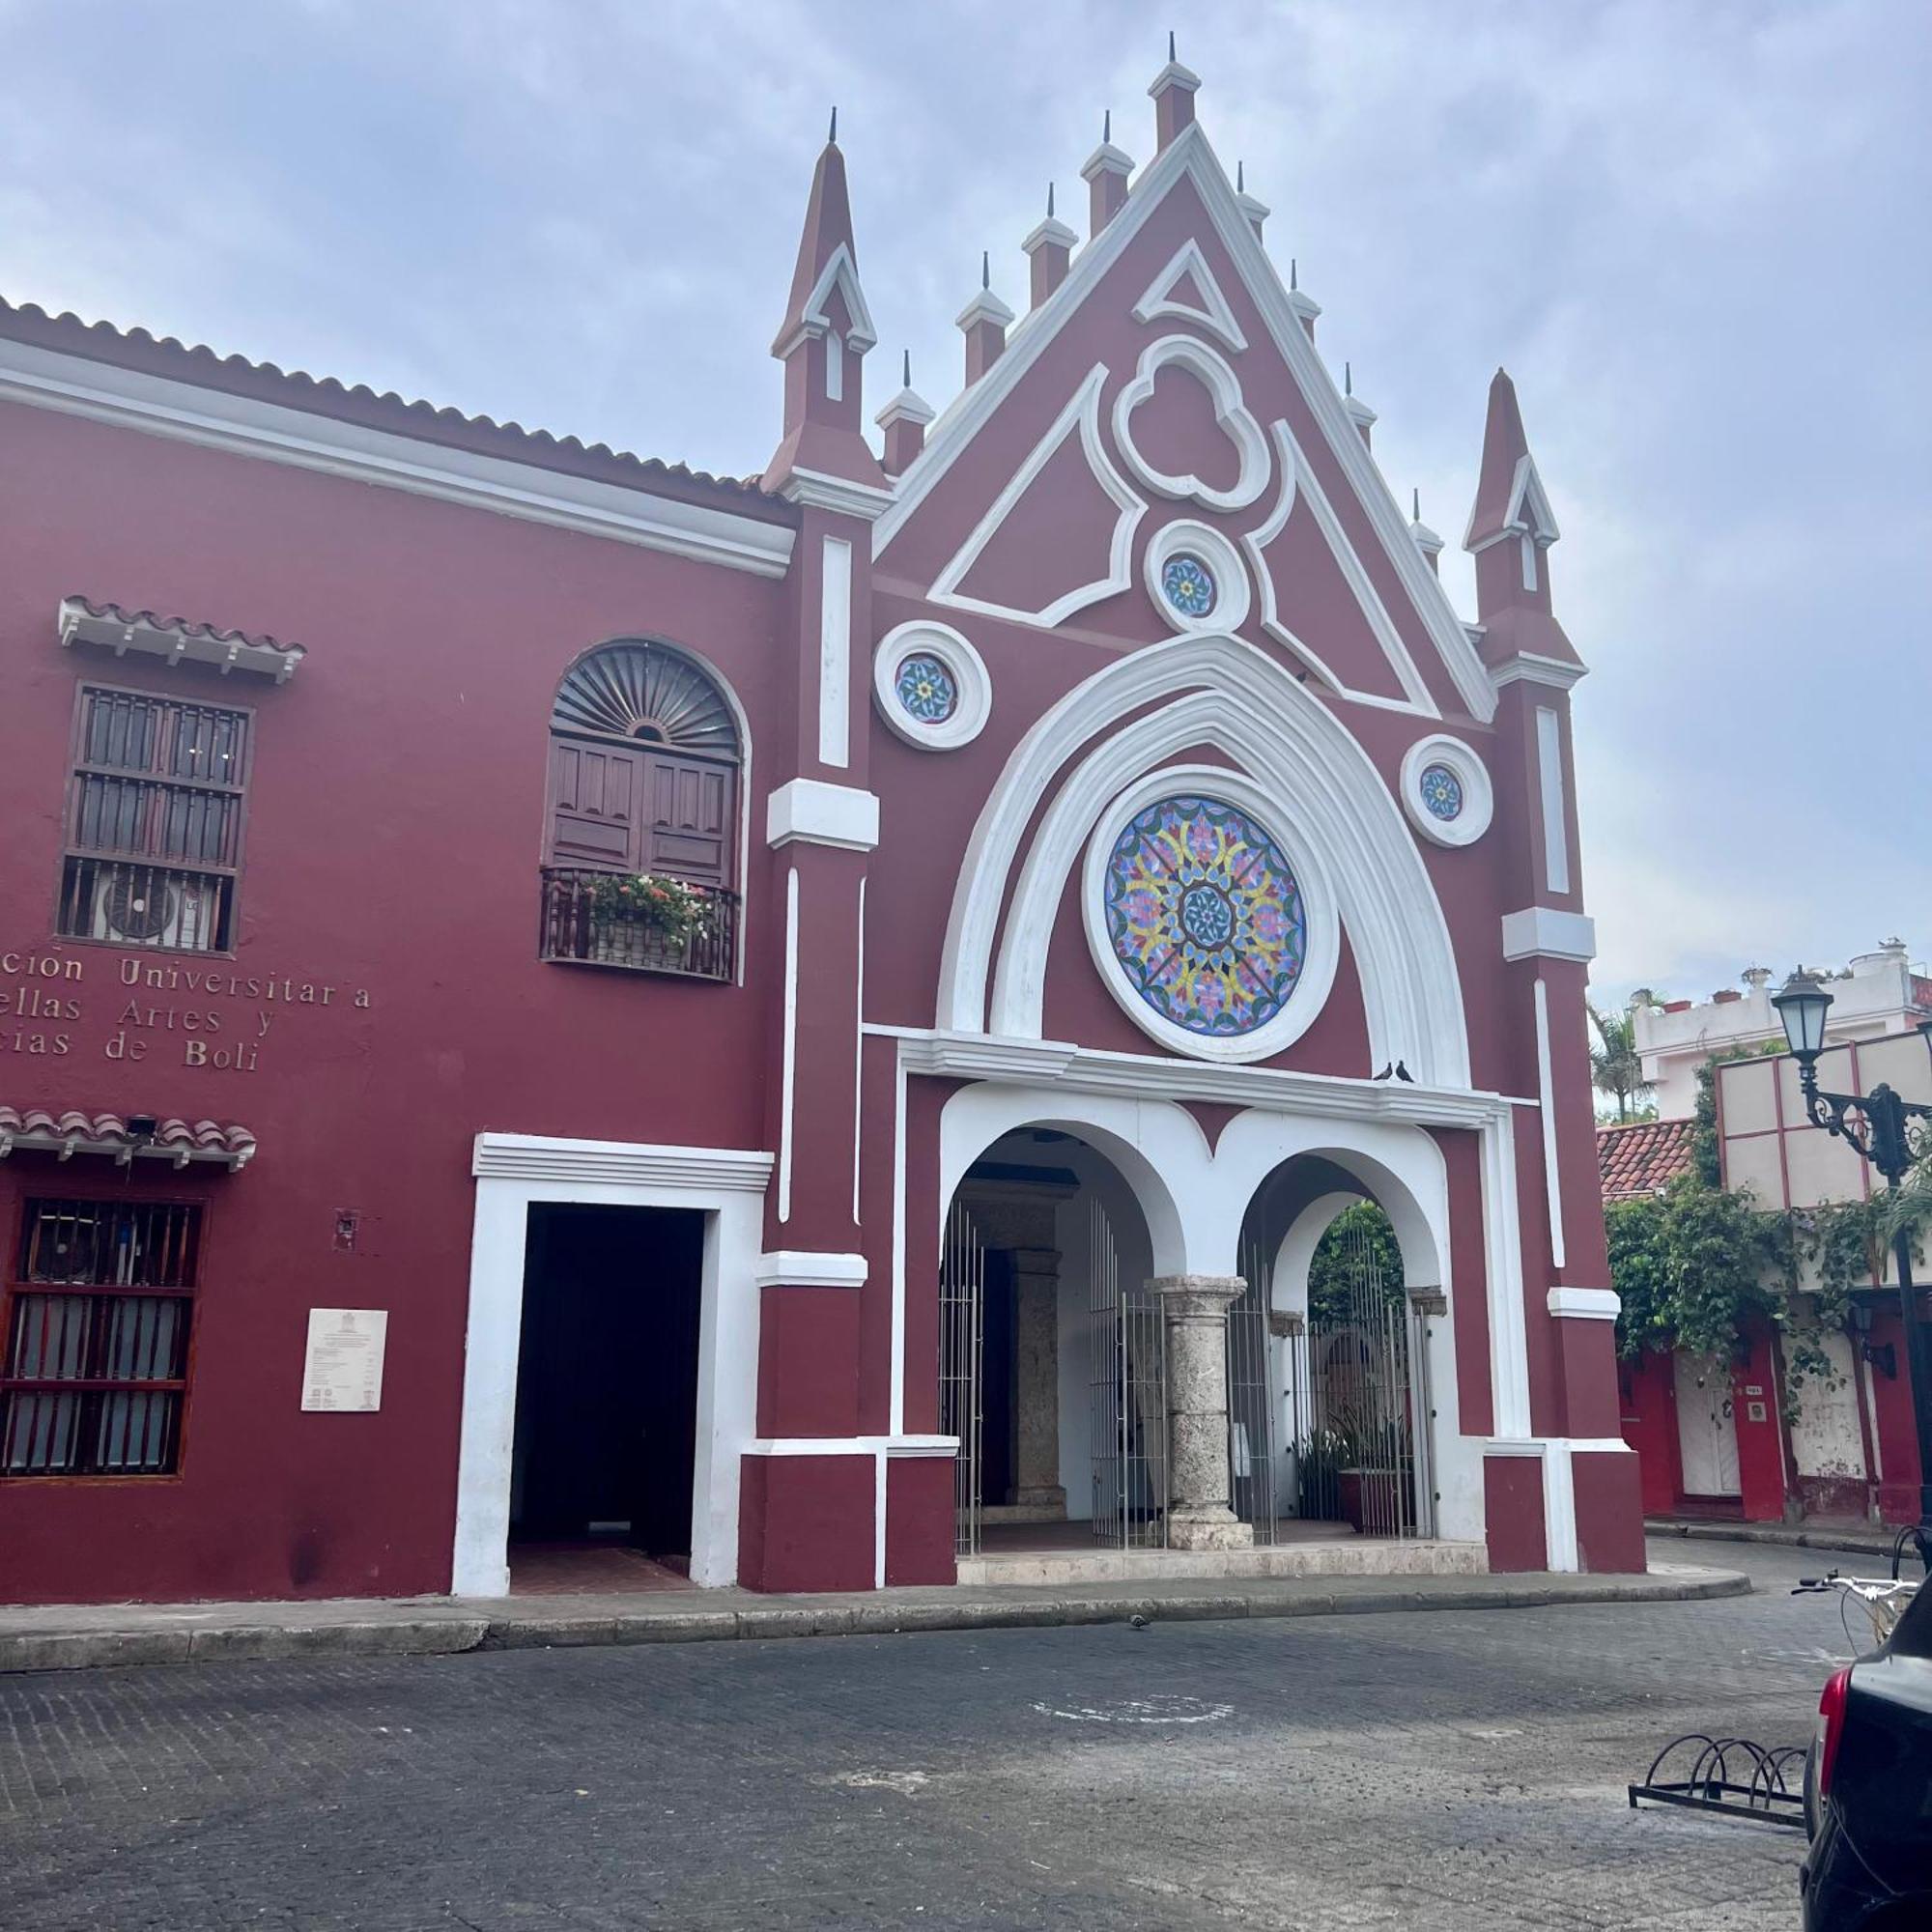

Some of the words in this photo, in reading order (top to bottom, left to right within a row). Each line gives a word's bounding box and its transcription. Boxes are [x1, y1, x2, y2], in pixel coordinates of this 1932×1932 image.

[116, 999, 220, 1033] Artes
[257, 1010, 274, 1037] y
[104, 1032, 147, 1061] de
[184, 1039, 259, 1071] Boli
